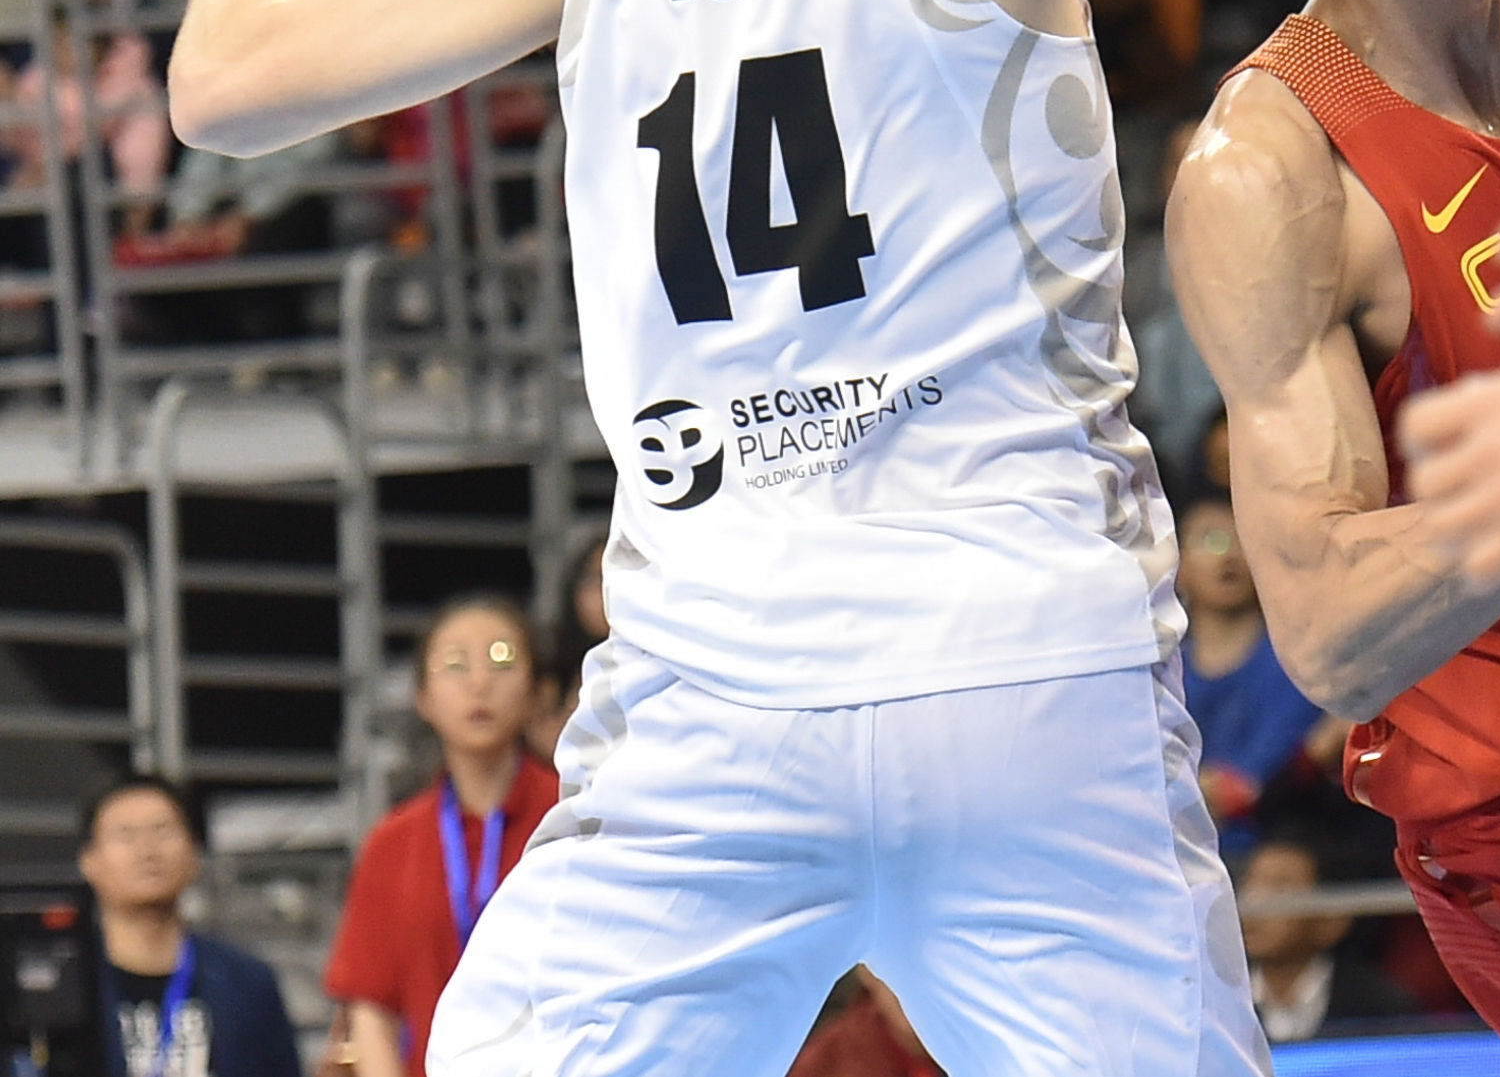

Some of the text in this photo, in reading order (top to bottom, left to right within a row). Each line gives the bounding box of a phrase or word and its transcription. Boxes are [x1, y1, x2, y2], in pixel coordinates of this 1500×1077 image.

[636, 47, 876, 326] 14
[730, 372, 889, 429] SECURITY
[736, 375, 943, 467] PLACEMENTS
[744, 465, 806, 489] HOLDING
